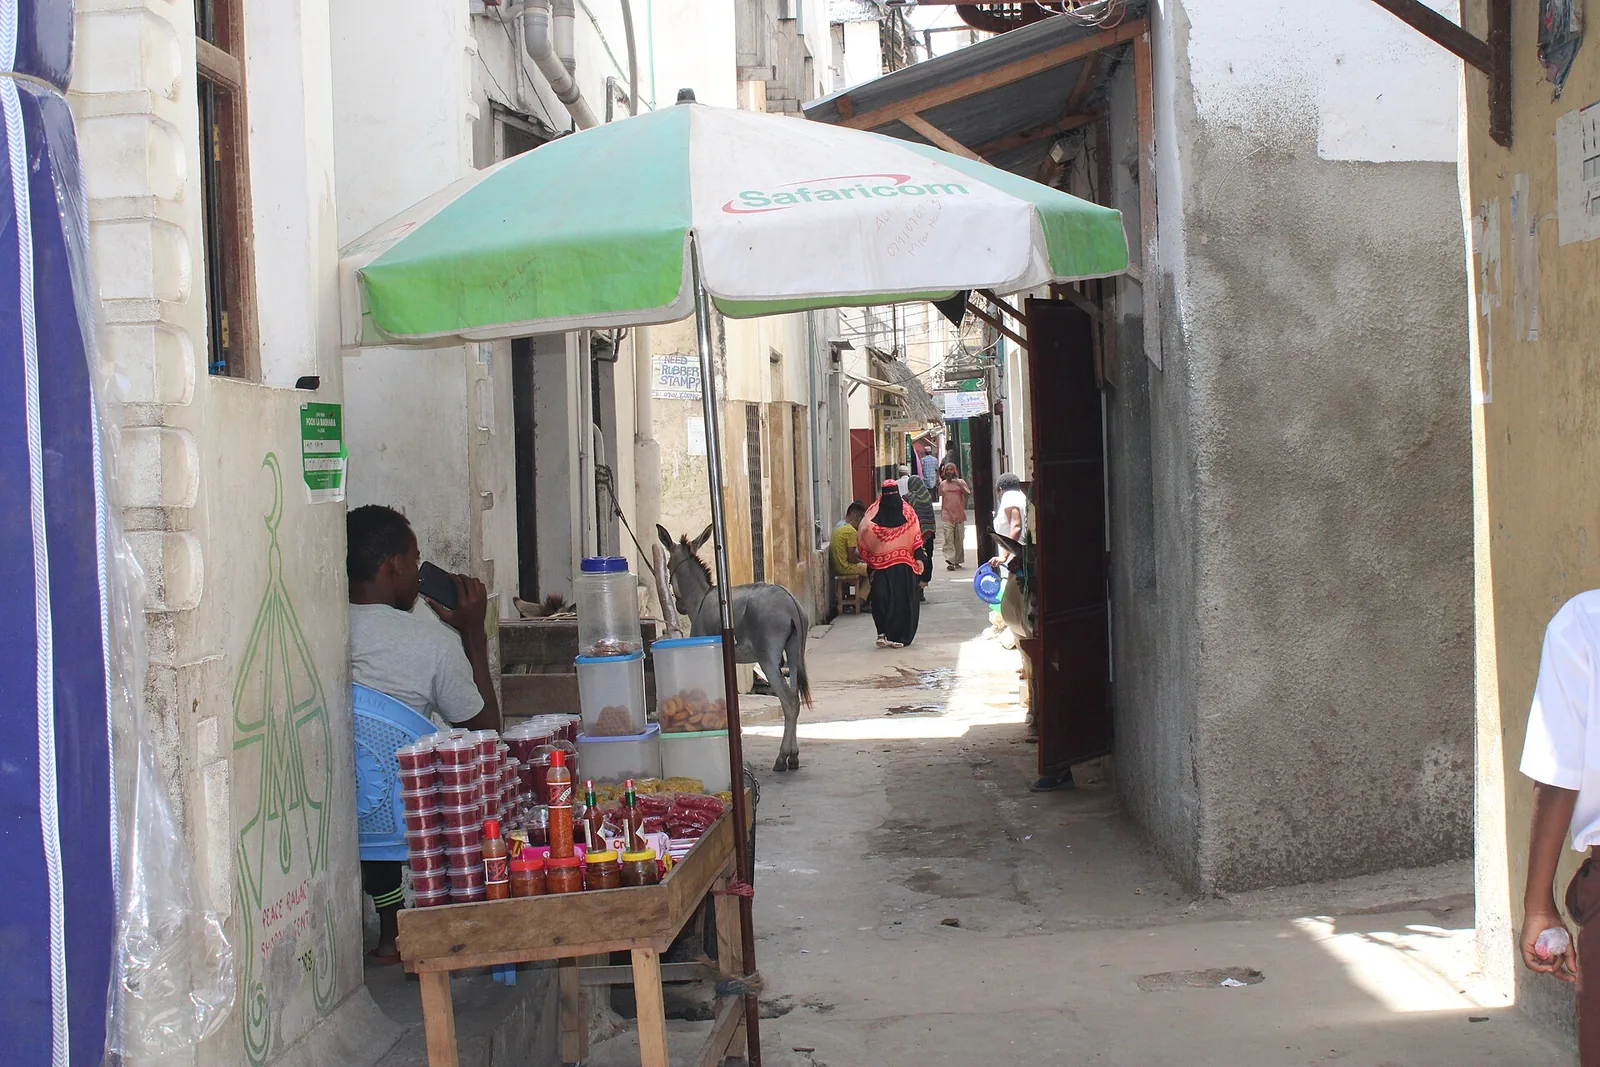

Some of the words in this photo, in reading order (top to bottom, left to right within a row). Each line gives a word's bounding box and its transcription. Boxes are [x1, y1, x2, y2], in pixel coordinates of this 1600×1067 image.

[738, 182, 970, 208] Safaricom
[664, 356, 687, 365] NEED
[662, 365, 699, 377] RUBBER
